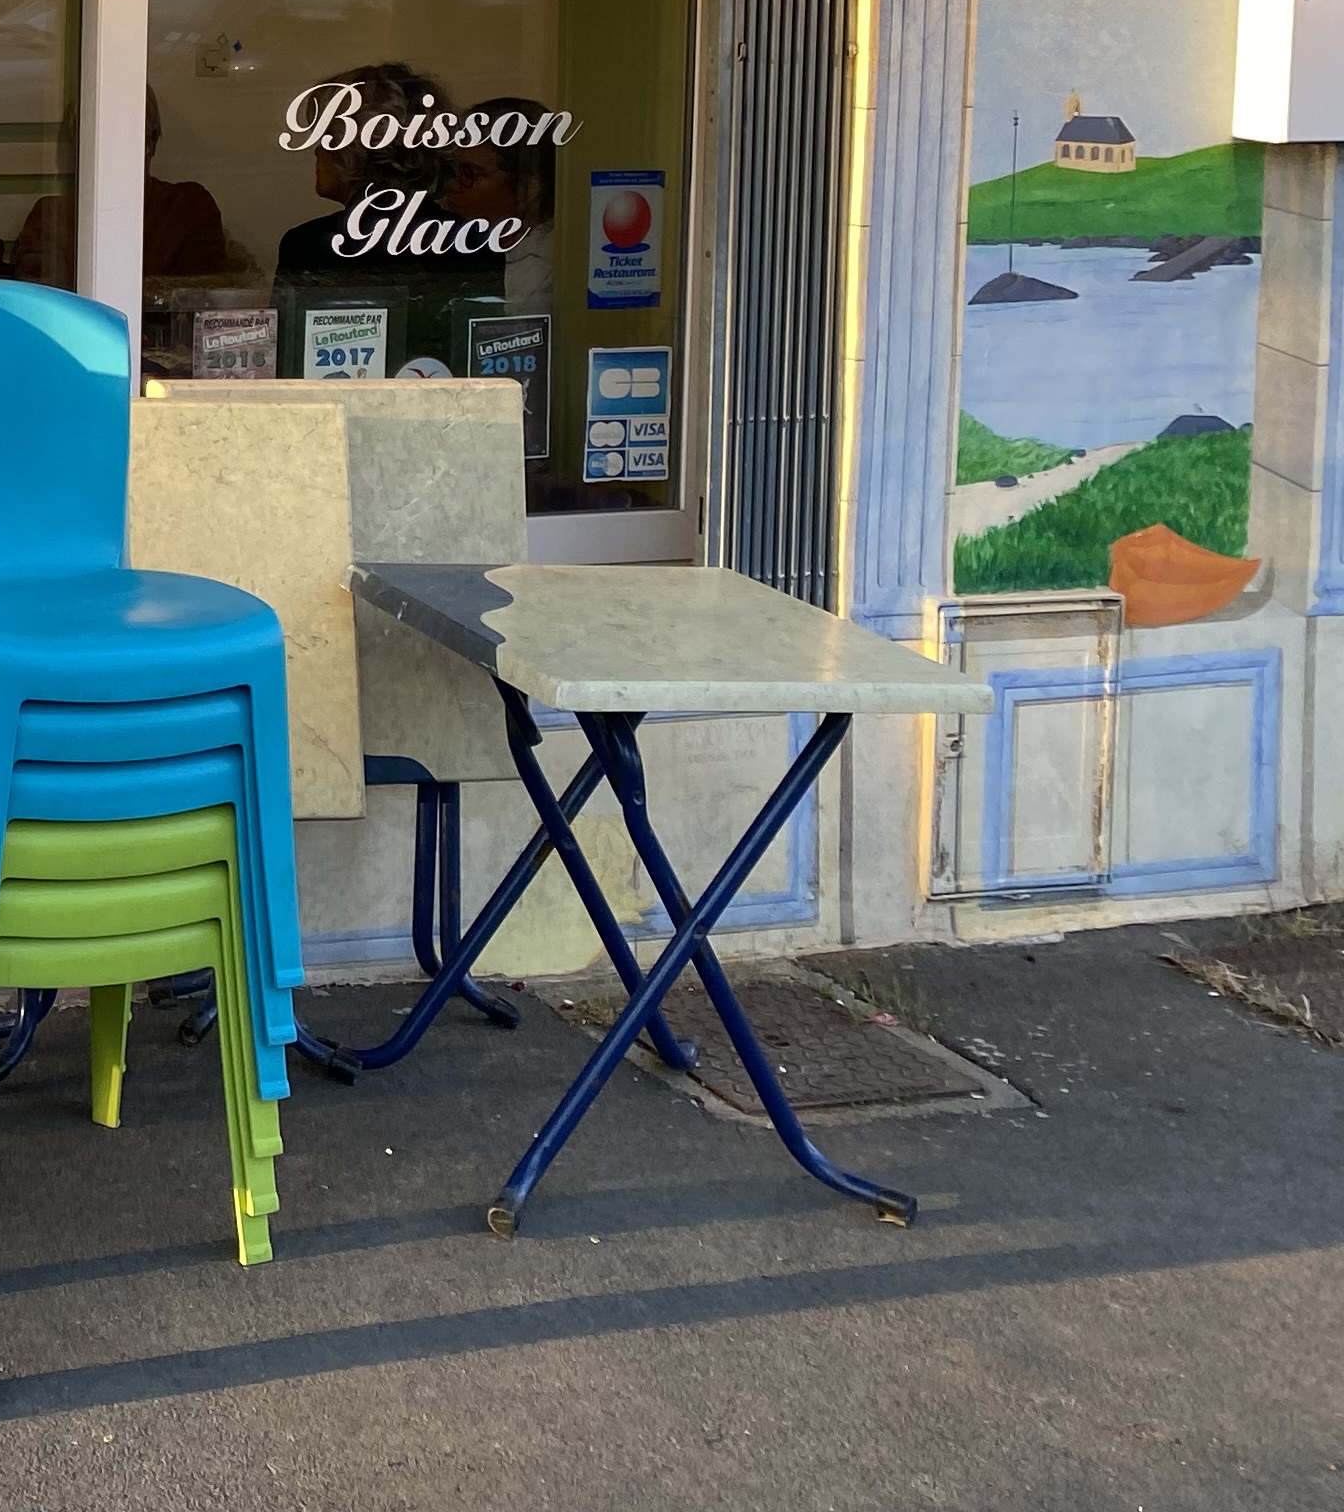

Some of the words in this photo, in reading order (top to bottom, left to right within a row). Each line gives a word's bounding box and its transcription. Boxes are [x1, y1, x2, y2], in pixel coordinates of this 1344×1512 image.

[278, 82, 585, 152] Boisson
[332, 183, 531, 258] Glace
[609, 256, 642, 267] Ticket
[593, 268, 656, 279] Restaurant
[313, 313, 365, 326] RECOMMANDÉ
[366, 314, 382, 326] PAR
[207, 351, 267, 369] 2016
[315, 347, 376, 367] 2017
[480, 355, 538, 375] 2018
[634, 423, 666, 436] VISA
[633, 453, 665, 466] VISA
